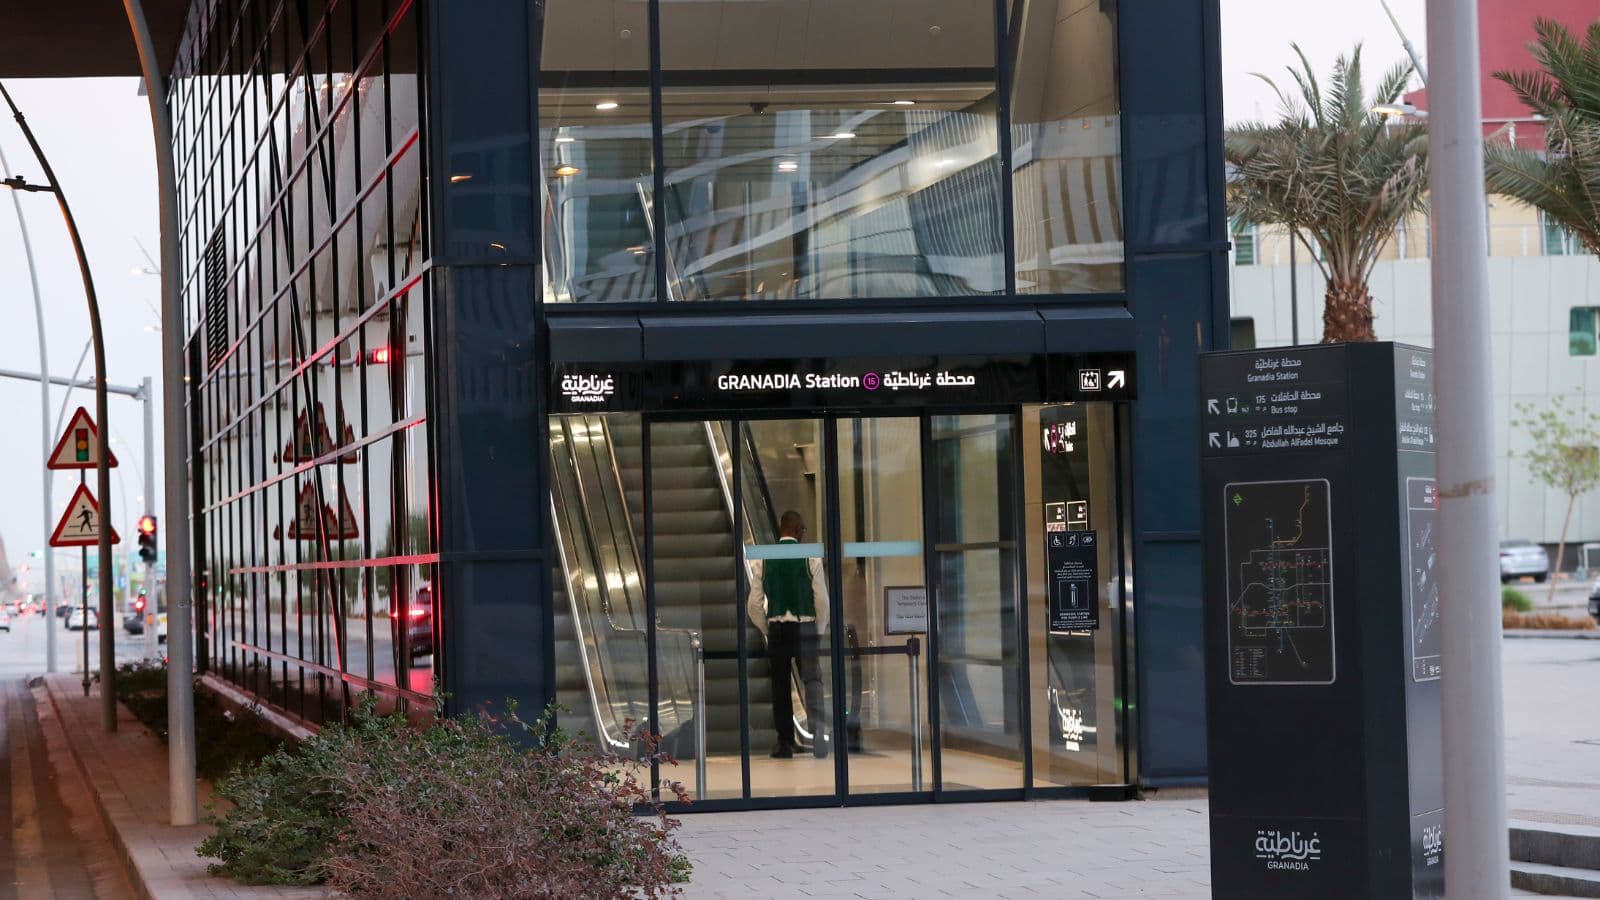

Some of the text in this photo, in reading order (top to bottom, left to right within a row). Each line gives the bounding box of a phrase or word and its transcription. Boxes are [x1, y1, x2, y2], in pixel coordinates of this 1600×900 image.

[1281, 357, 1302, 367] محطة
[718, 373, 801, 390] GRANADIA
[805, 373, 859, 388] Station
[867, 377, 876, 386] 15
[936, 371, 975, 386] محطة
[1247, 371, 1299, 383] Granadia Station
[1301, 391, 1321, 400] محطة
[1271, 405, 1283, 414] Bus
[1284, 405, 1298, 415] stop
[1262, 439, 1289, 448] Abdullah
[1314, 436, 1338, 447] Mosque
[1267, 861, 1309, 871] GRANADIA
